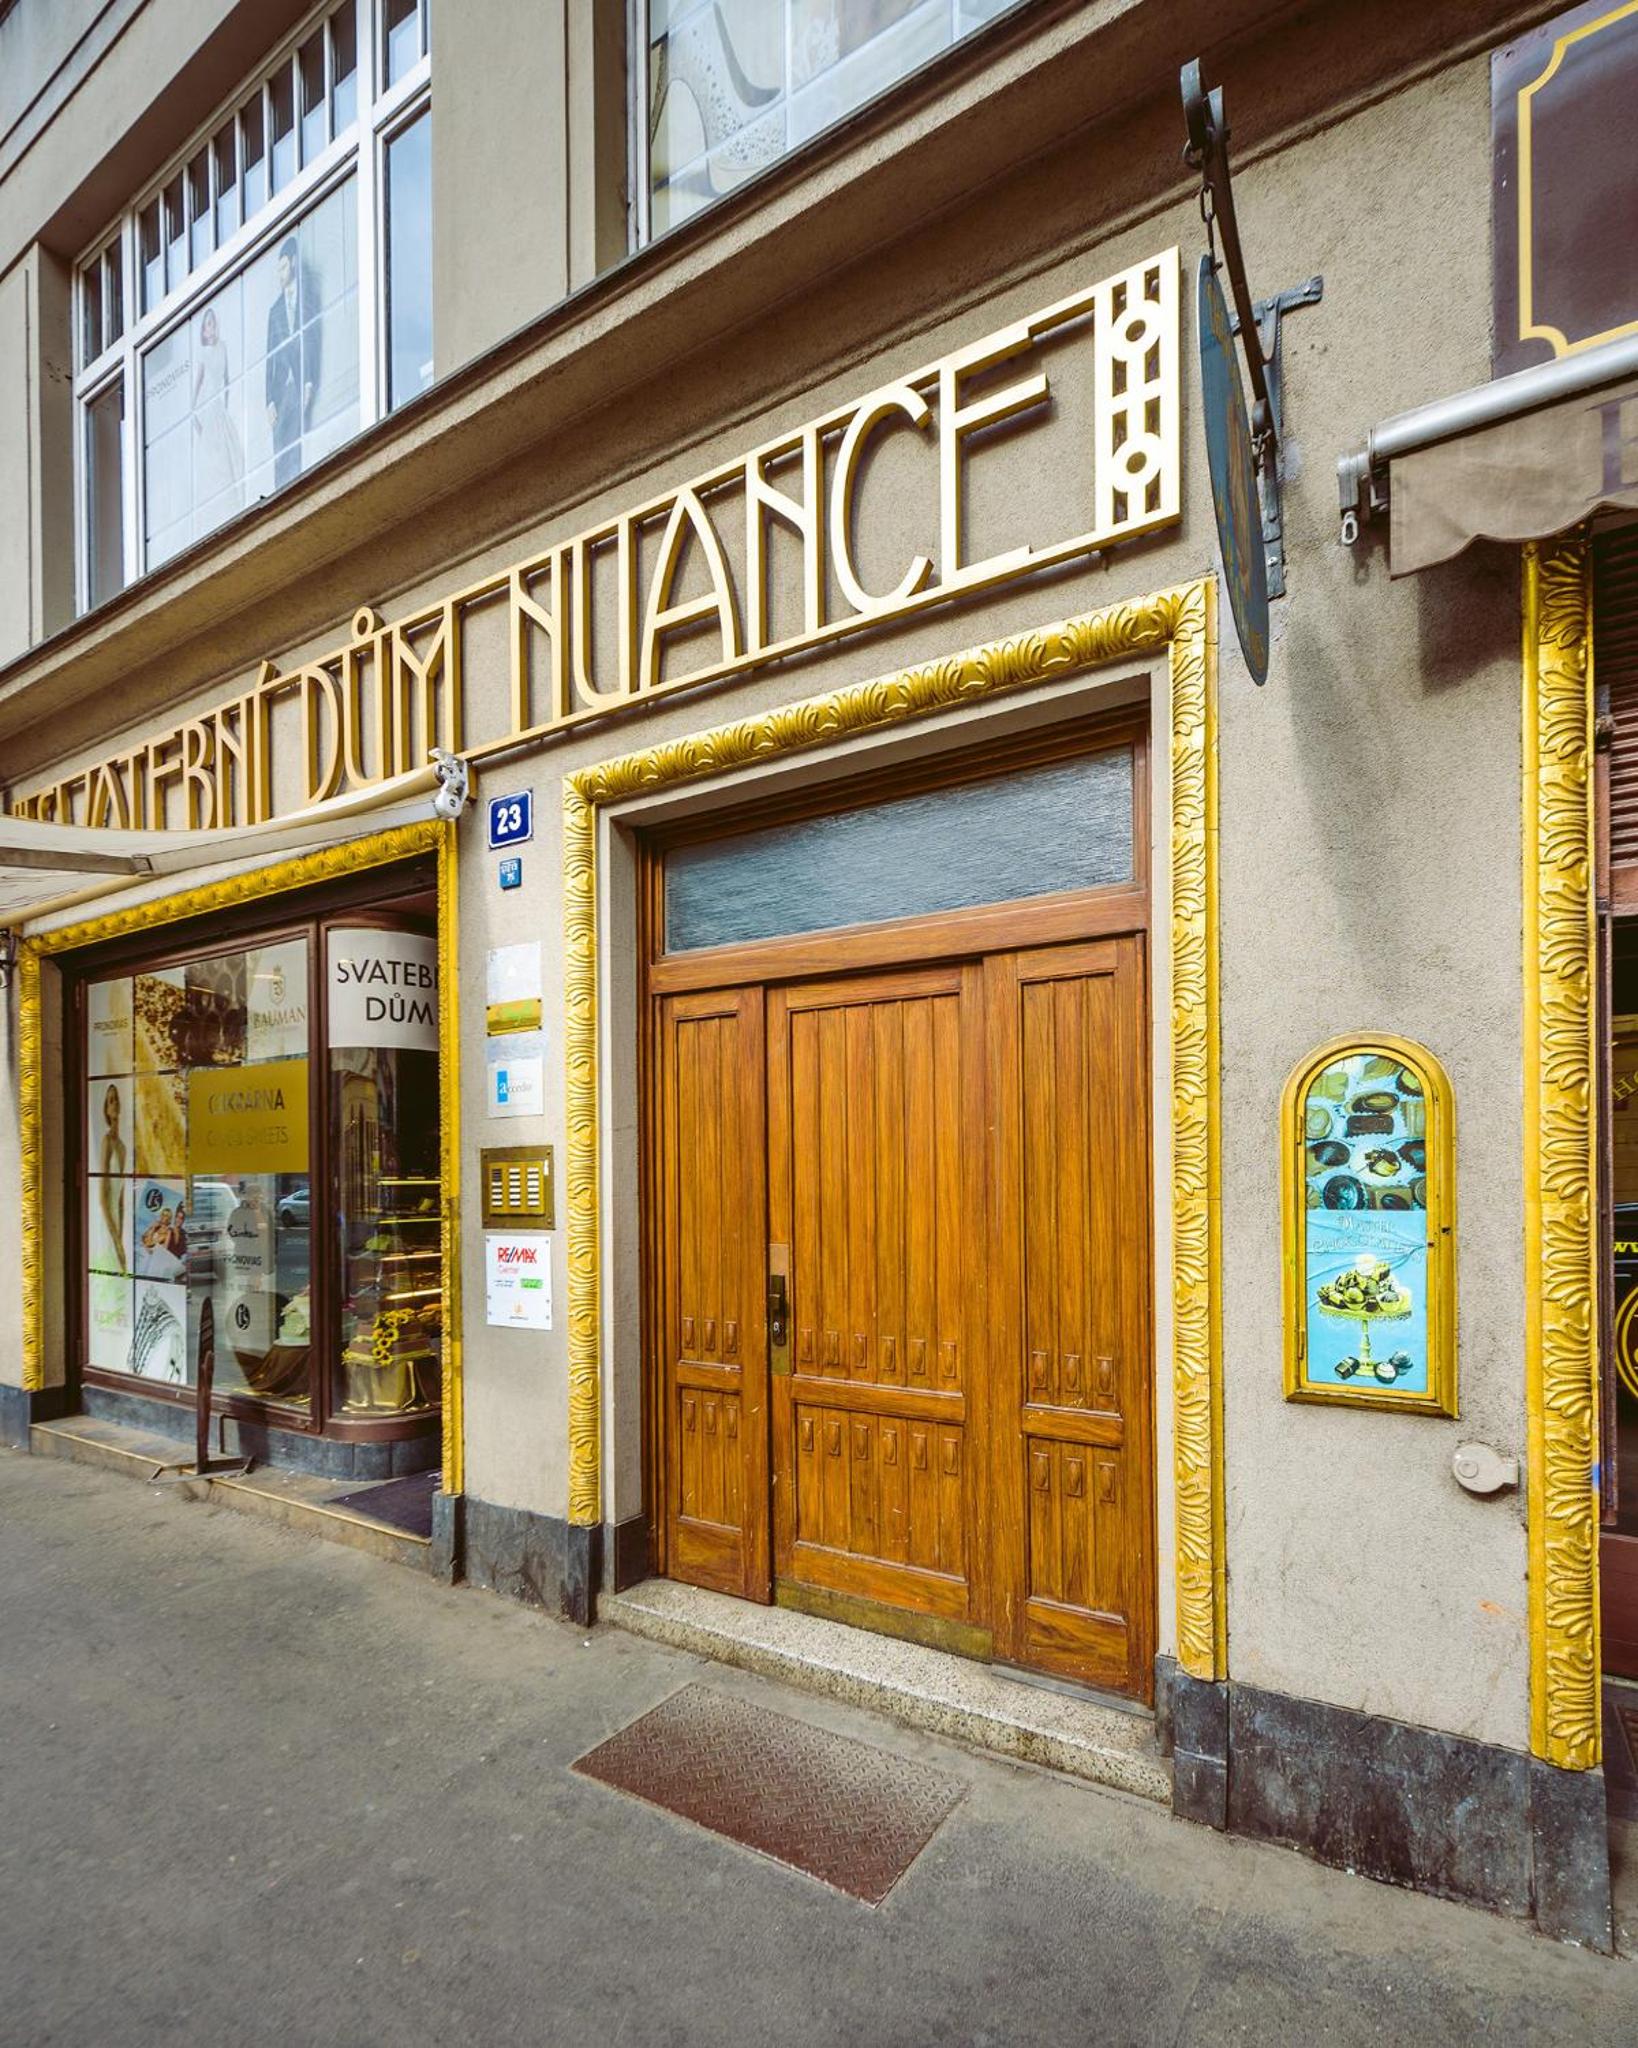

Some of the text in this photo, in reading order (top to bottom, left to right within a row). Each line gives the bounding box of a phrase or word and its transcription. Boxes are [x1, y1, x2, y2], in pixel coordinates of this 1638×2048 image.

[300, 600, 461, 804] DŮM
[509, 326, 1050, 735] NUANCE
[497, 803, 521, 835] 23
[337, 957, 438, 990] SVATEB
[366, 992, 433, 1026] DŮM
[498, 1247, 537, 1264] RE/MAX
